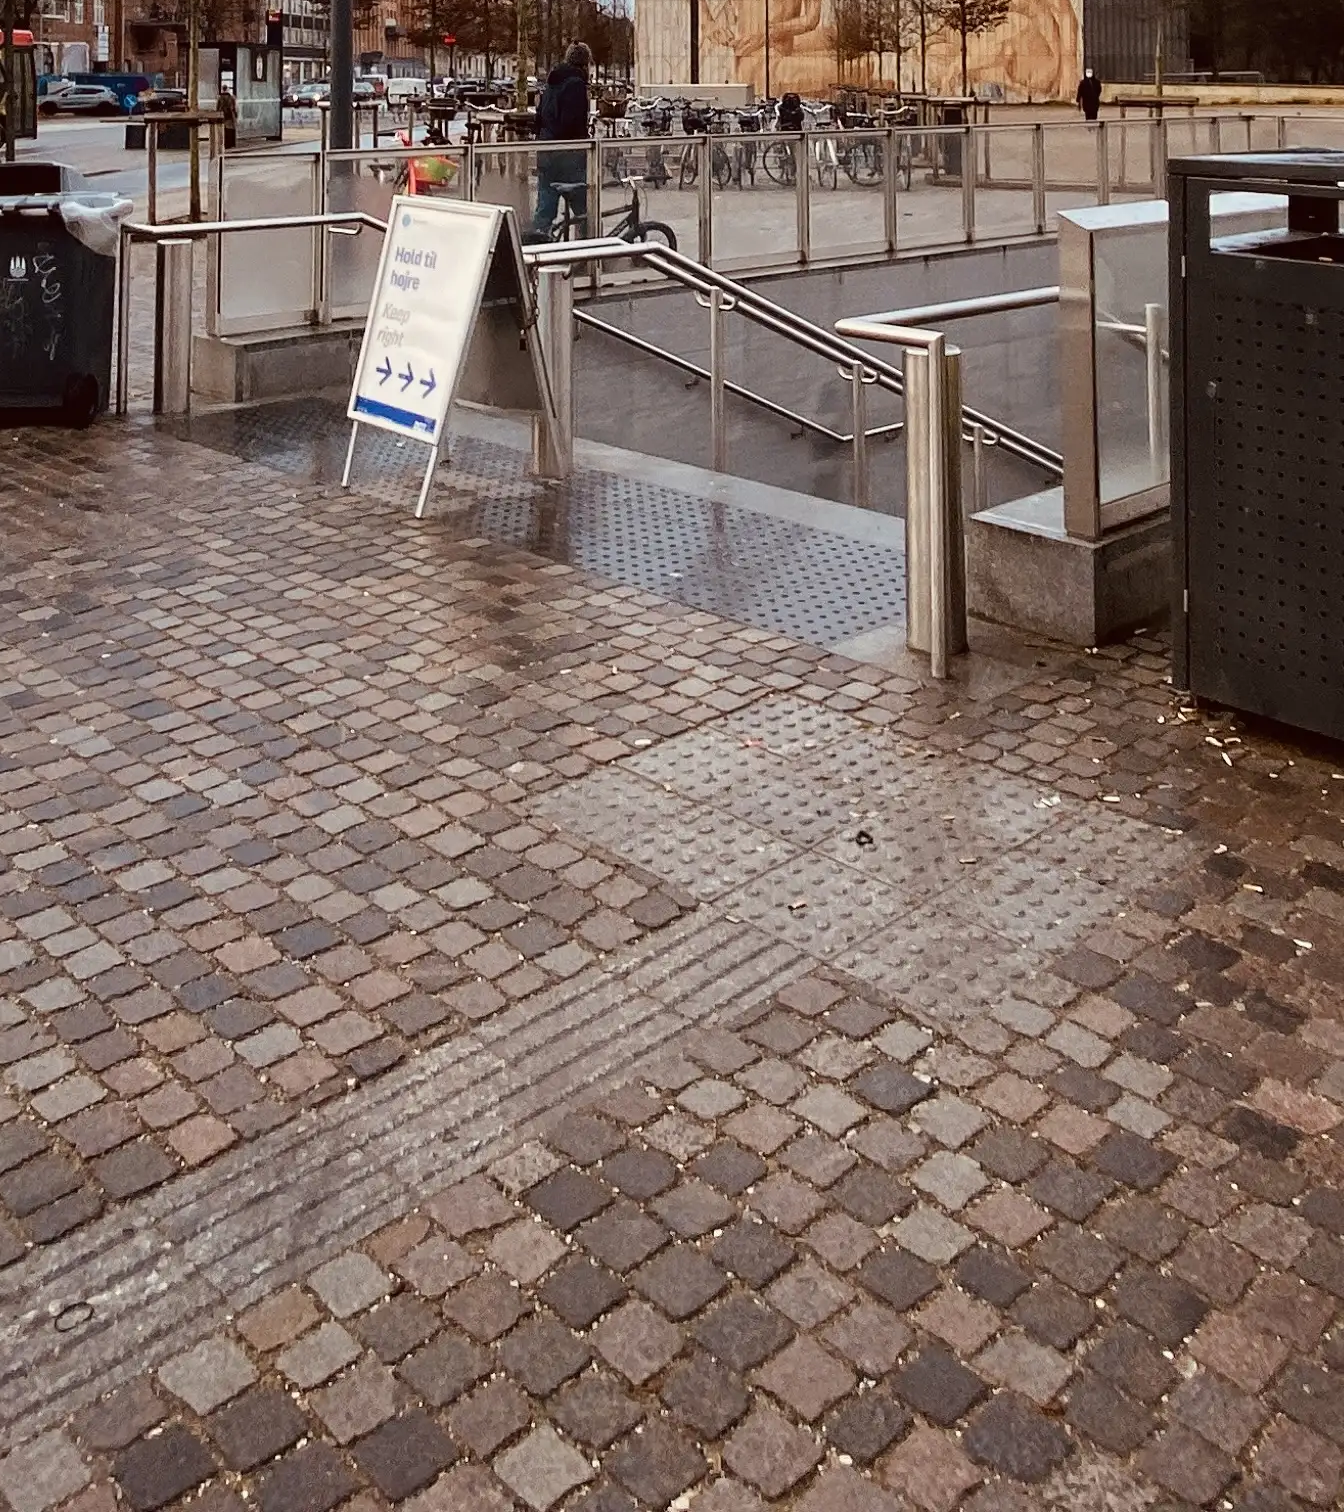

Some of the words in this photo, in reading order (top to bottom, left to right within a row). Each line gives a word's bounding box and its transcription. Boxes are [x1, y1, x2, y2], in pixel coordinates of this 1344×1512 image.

[395, 246, 423, 266] Hold
[424, 251, 437, 269] til
[390, 270, 420, 291] højre
[382, 303, 410, 325] Keep
[376, 326, 404, 348] right
